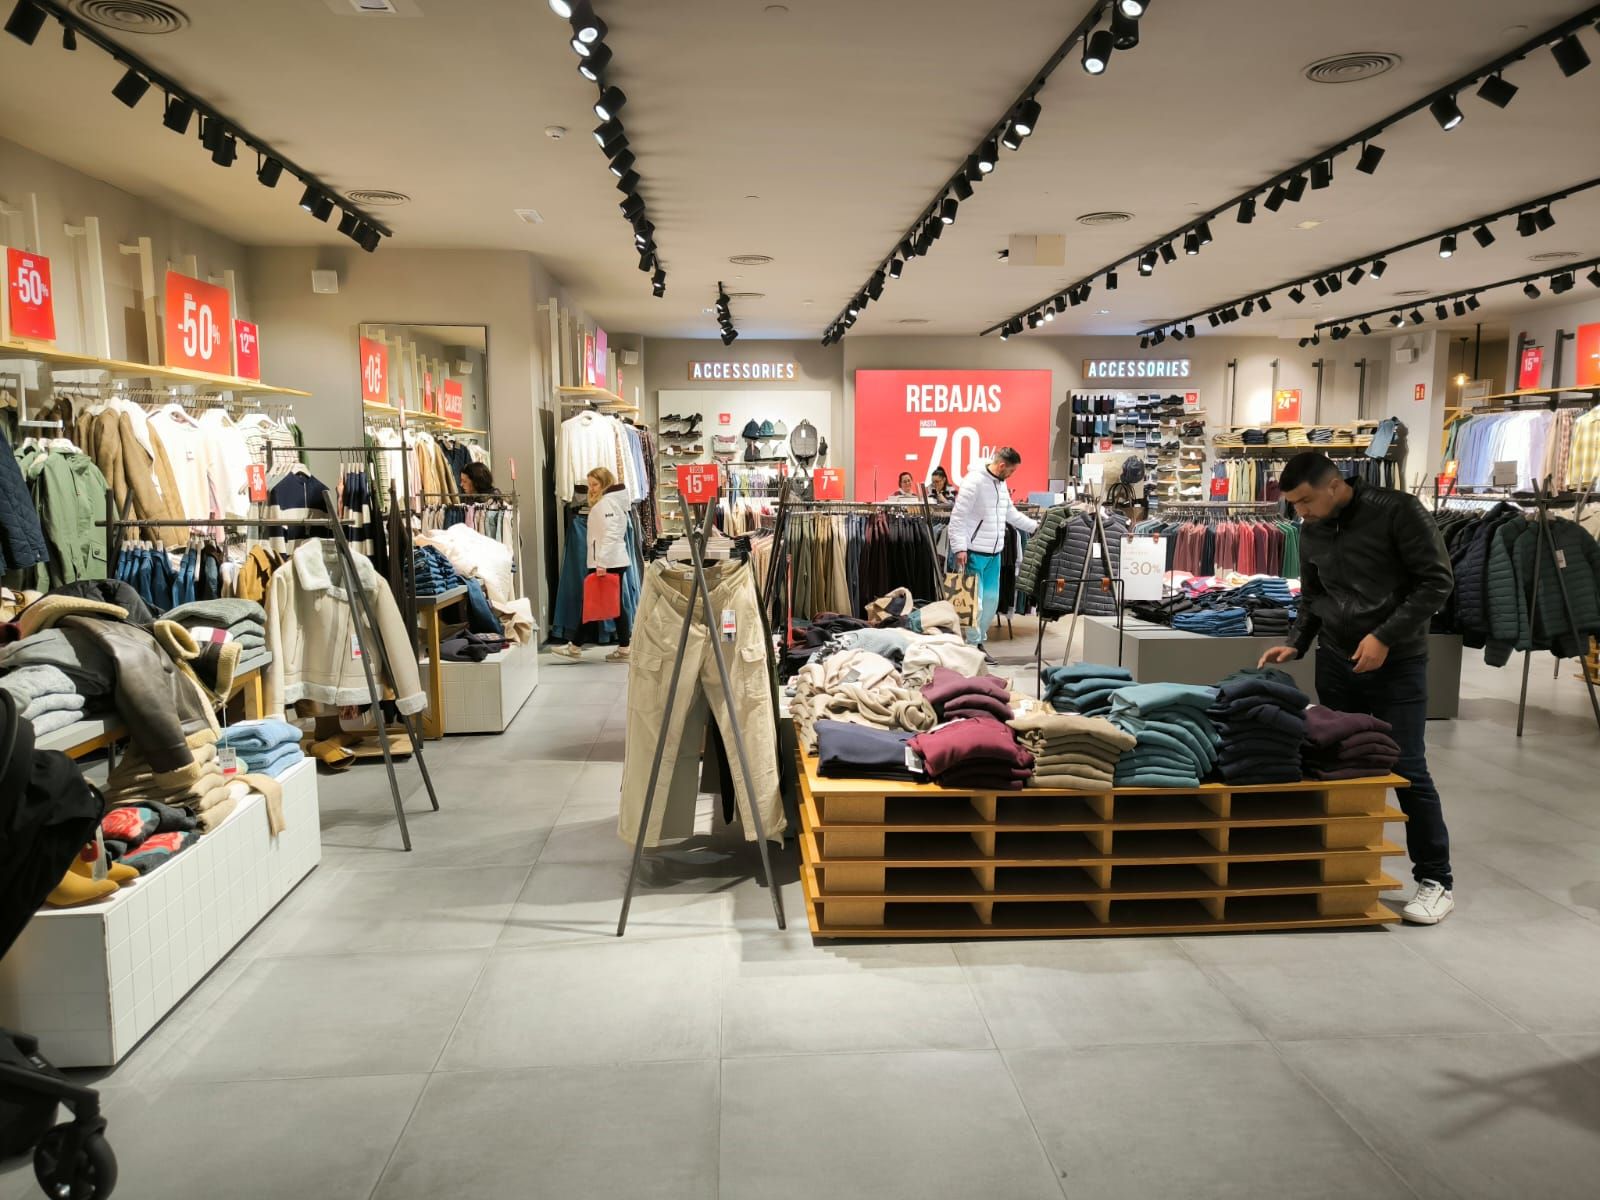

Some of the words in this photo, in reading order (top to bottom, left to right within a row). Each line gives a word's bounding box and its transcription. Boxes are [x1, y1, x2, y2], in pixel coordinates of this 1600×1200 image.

[12, 266, 49, 306] -50%
[178, 299, 220, 361] -50%
[693, 362, 794, 379] ACCESSORIES
[1088, 361, 1189, 377] ACCESSORIES
[906, 384, 1001, 413] REBAJAS
